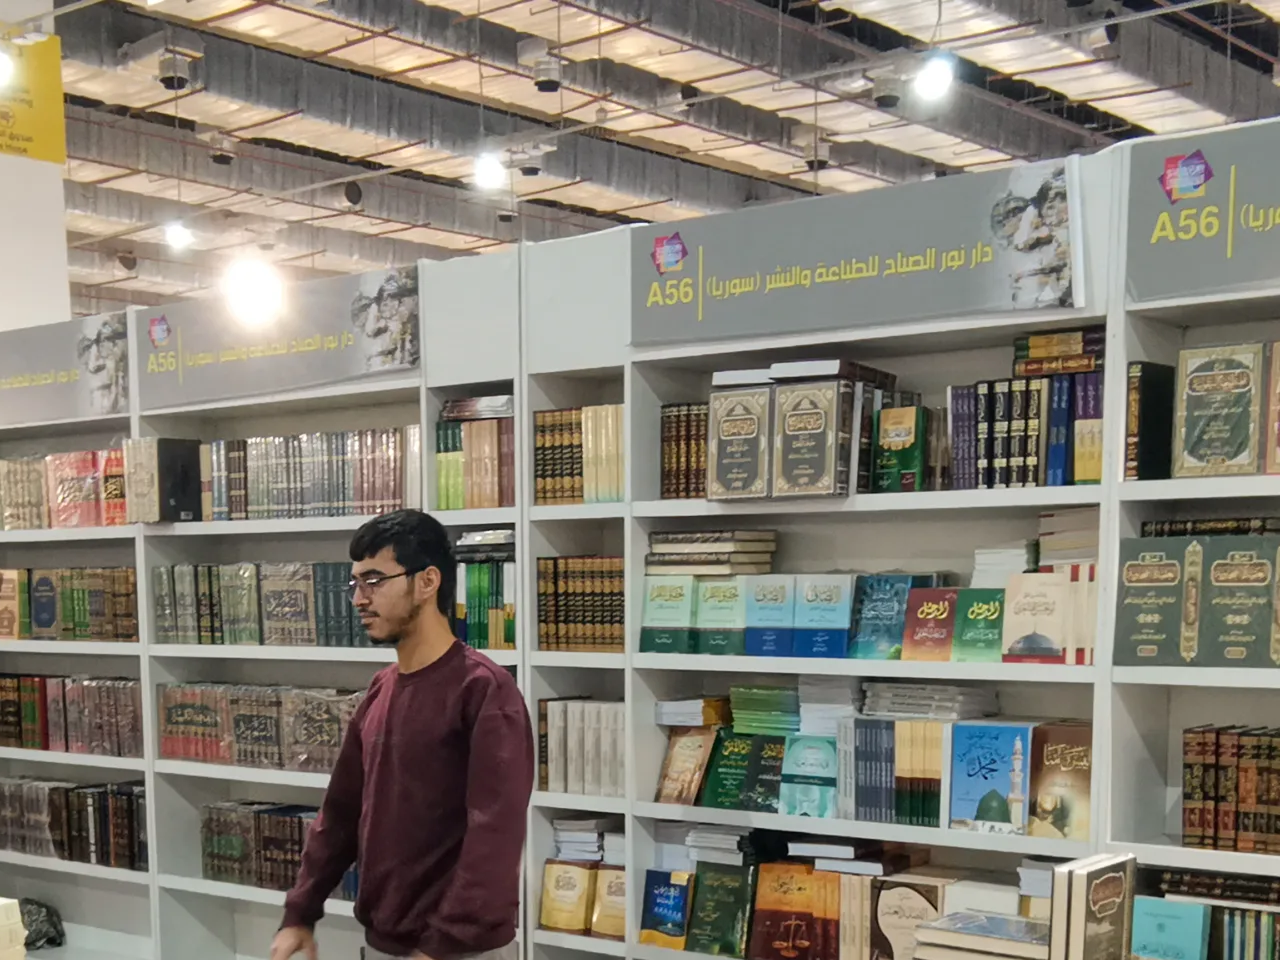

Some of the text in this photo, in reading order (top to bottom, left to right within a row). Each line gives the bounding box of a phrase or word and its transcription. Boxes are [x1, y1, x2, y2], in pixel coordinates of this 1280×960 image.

[1150, 205, 1220, 244] A56
[814, 255, 879, 285] للطباعة
[939, 243, 966, 272] نور
[970, 241, 994, 270] دار
[646, 277, 694, 308] A56
[706, 271, 761, 300] (سوريا)
[764, 264, 812, 294] والنشر
[147, 352, 177, 374] A56
[917, 600, 950, 620] المدخل
[967, 600, 1000, 621] المدخل
